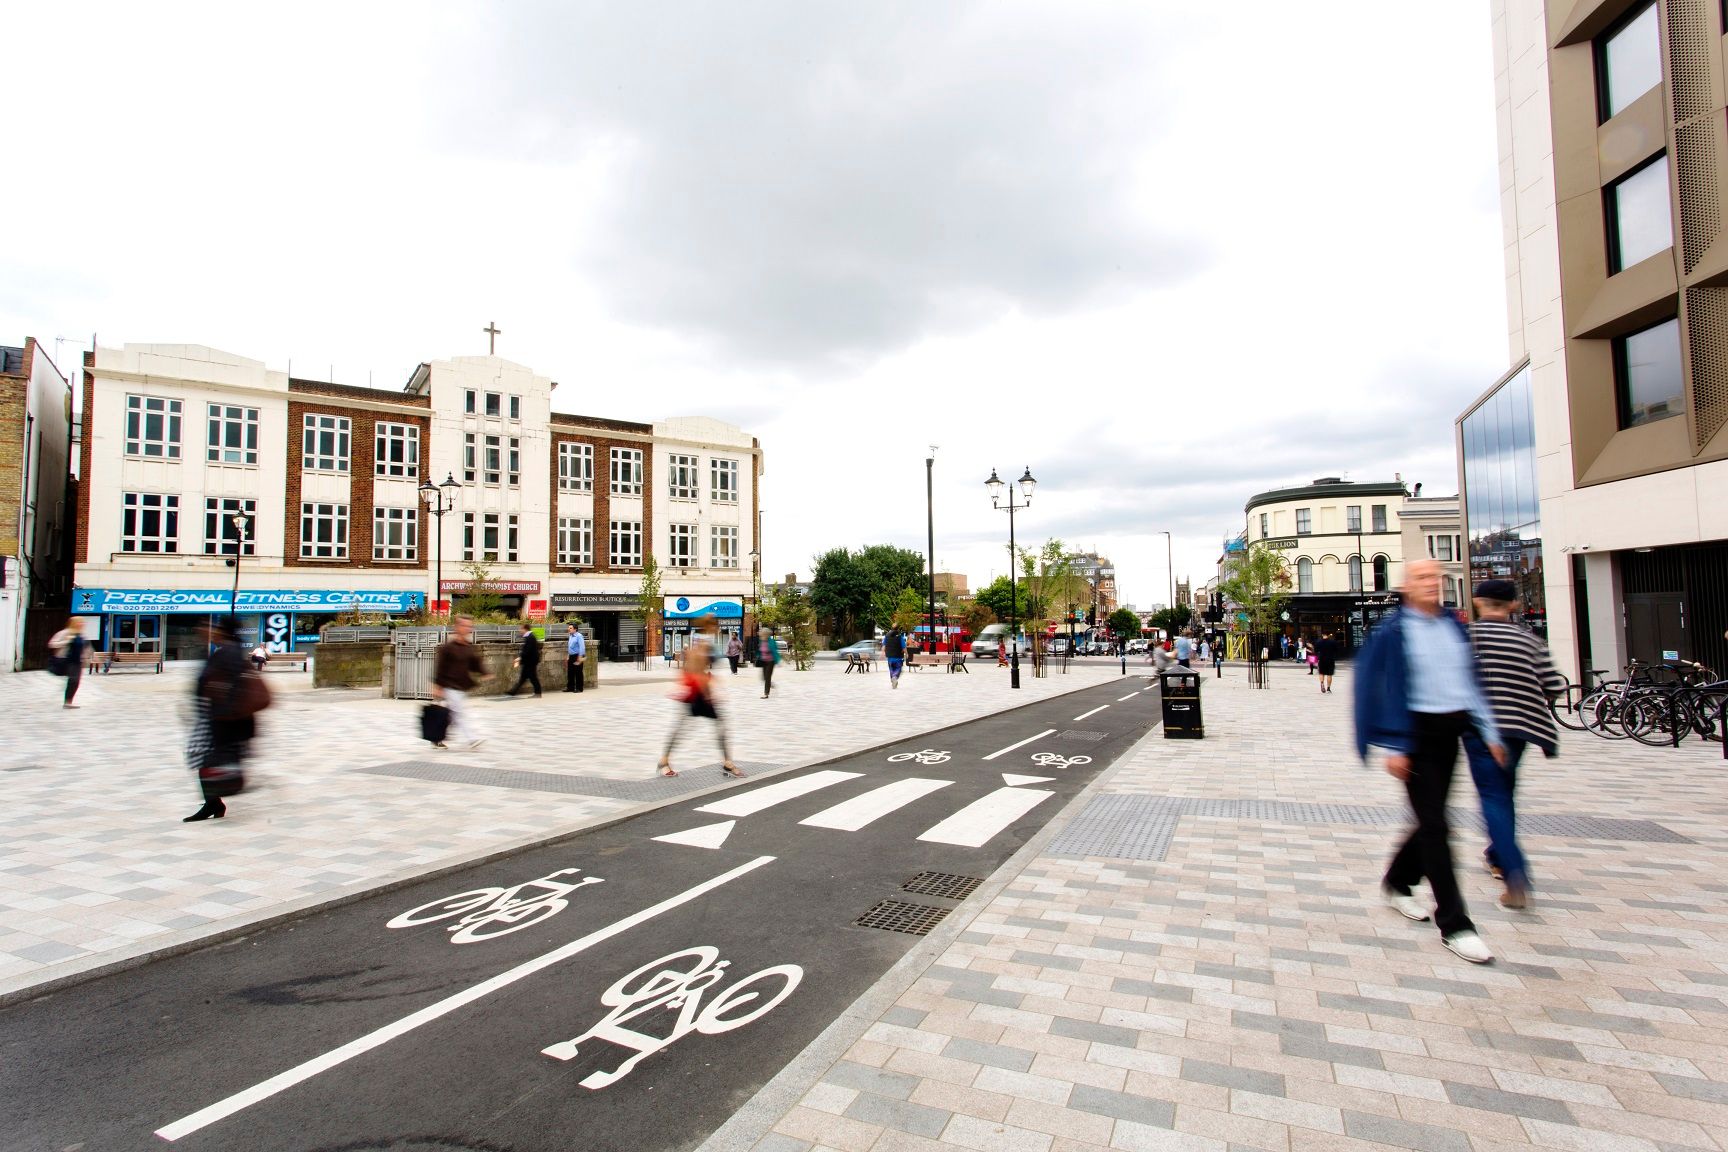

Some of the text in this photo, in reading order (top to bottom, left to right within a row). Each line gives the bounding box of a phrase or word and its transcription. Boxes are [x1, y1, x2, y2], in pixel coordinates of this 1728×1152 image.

[512, 583, 538, 591] CHURCH
[104, 591, 401, 603] PERSONAL FITNESS CENTRE
[265, 613, 289, 653] GYM
